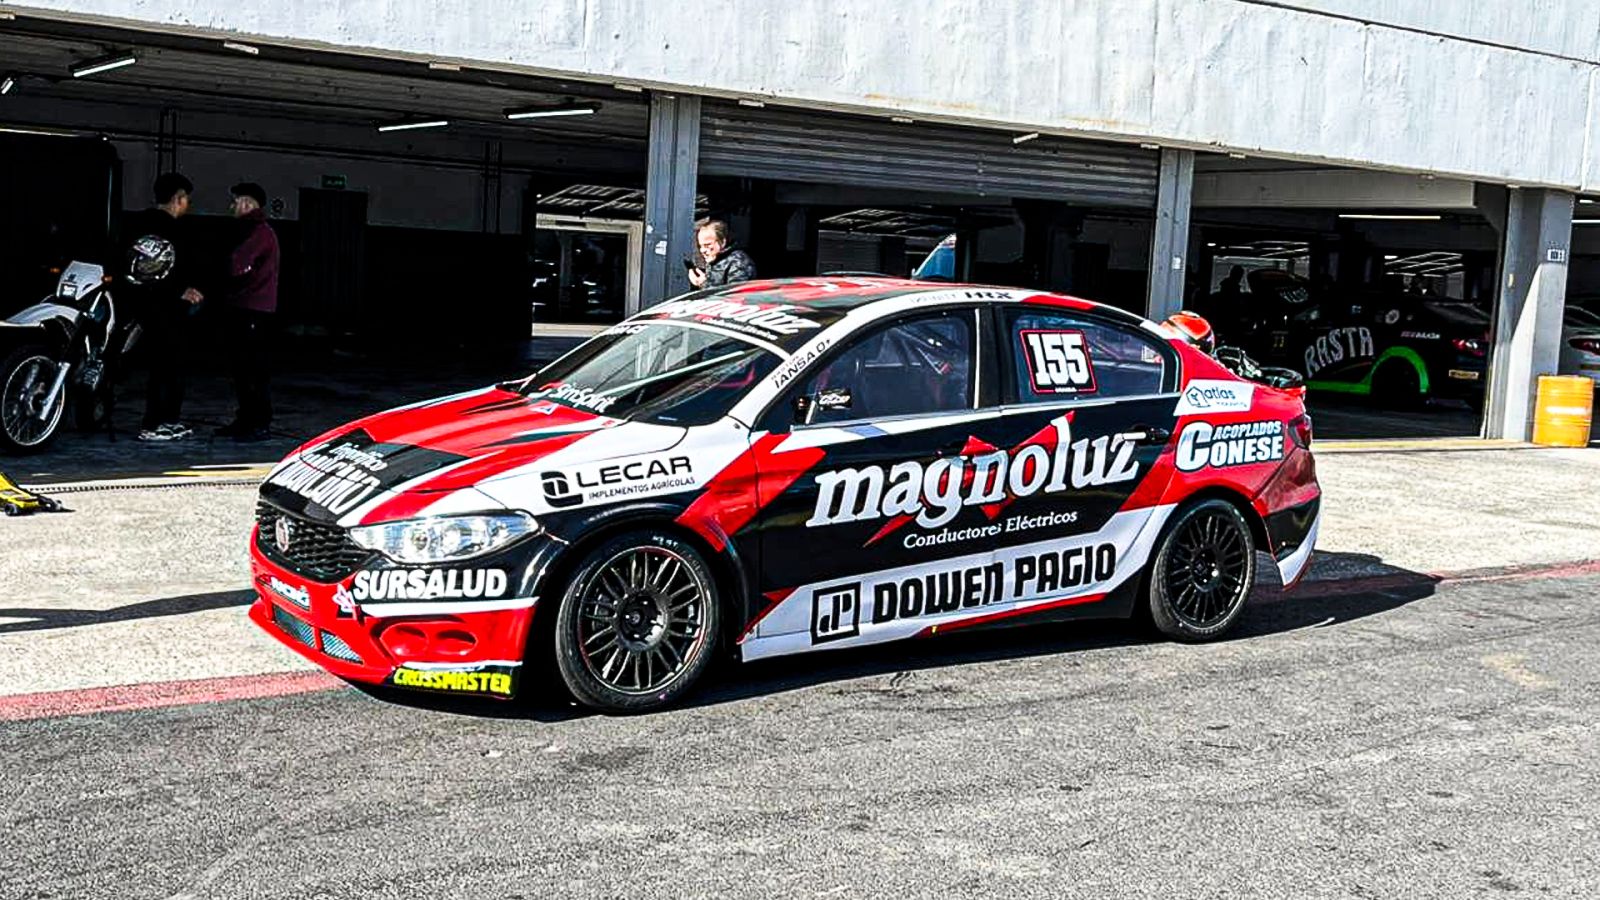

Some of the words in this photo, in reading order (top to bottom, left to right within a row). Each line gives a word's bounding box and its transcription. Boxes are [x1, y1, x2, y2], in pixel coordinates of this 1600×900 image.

[1027, 333, 1090, 386] 155
[1304, 327, 1374, 379] RASTA
[1204, 386, 1236, 400] atlas
[1175, 421, 1284, 472] CONESE
[1212, 421, 1282, 441] ACOPLADOS
[576, 456, 693, 488] LECAR
[588, 484, 649, 500] IMPLEMENTOS
[650, 477, 696, 491] AGRÍCOLAS
[805, 415, 1146, 529] magnoluz
[903, 523, 1002, 549] Conductores
[1005, 510, 1078, 533] Eléctricos
[353, 569, 508, 600] SURSALUD
[872, 561, 1004, 625] DOWEN
[1013, 543, 1117, 597] PAGIO
[393, 668, 512, 694] CROSSMASTER
